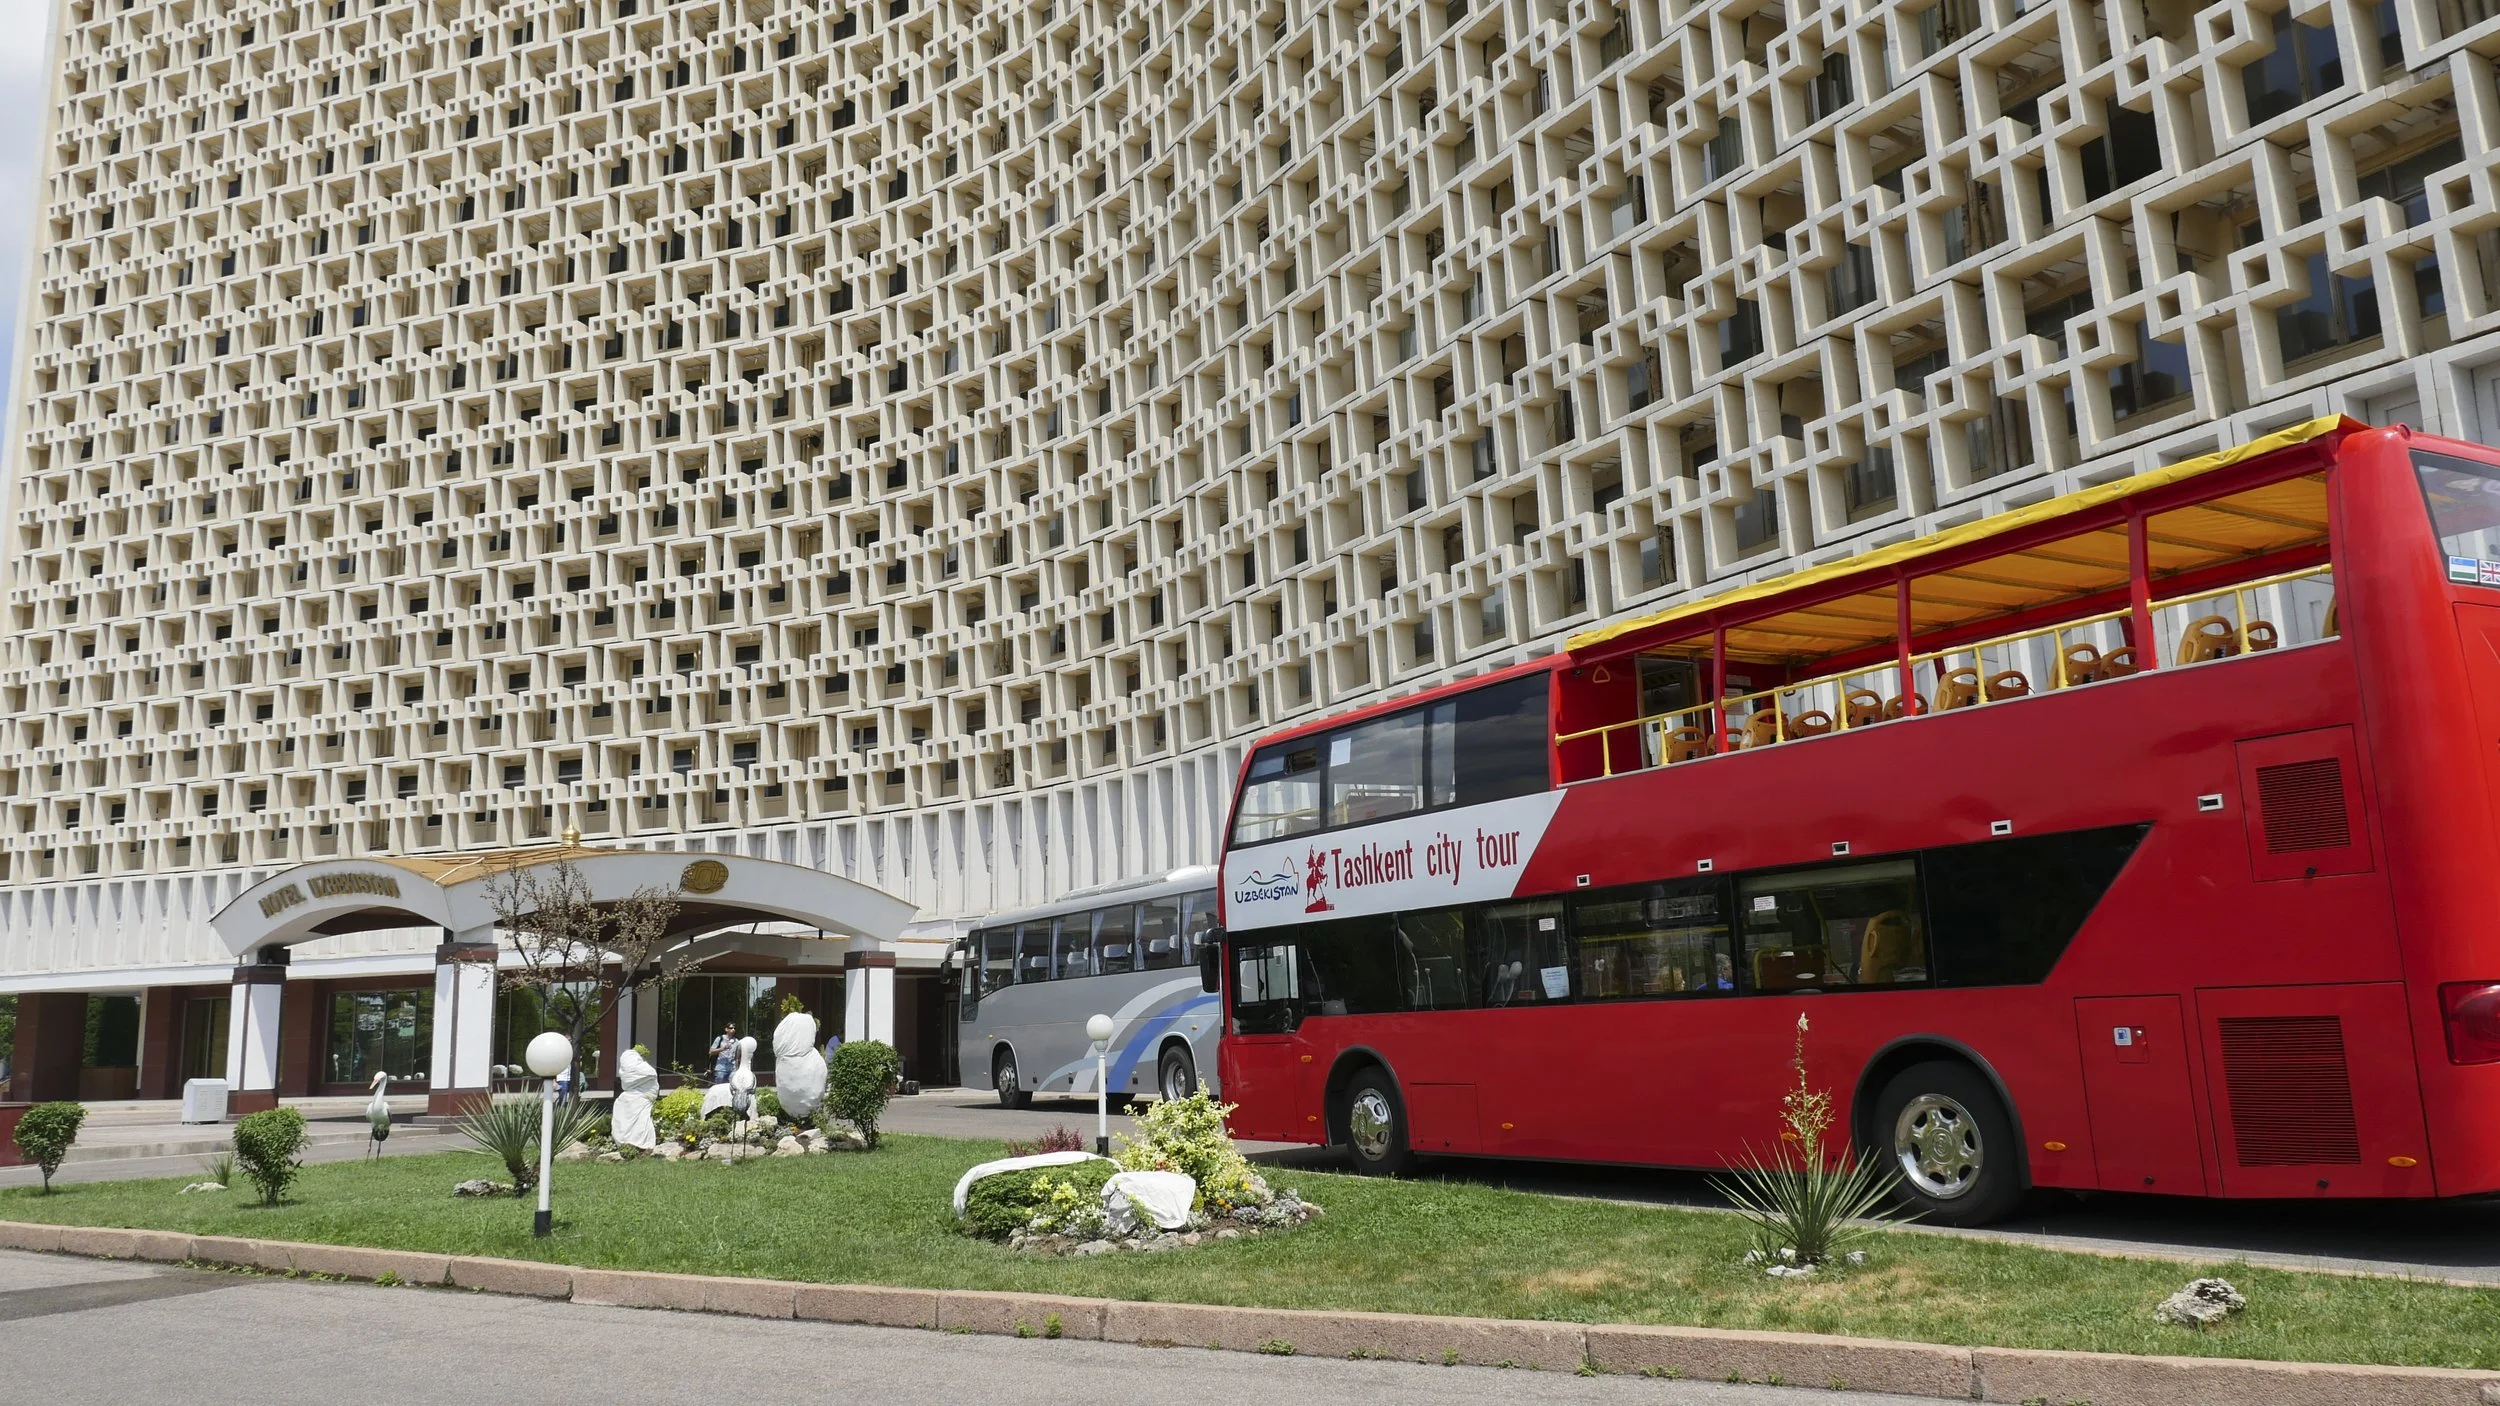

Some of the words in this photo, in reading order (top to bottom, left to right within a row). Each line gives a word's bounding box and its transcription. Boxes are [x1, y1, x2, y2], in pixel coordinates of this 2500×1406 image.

[1330, 839, 1413, 889] Tashkent
[1426, 831, 1462, 886] city
[1476, 827, 1520, 870] tour
[258, 883, 306, 919] HOTEL
[306, 872, 400, 899] UZBEKISTAN
[1234, 882, 1299, 904] UZBEKISTAN
